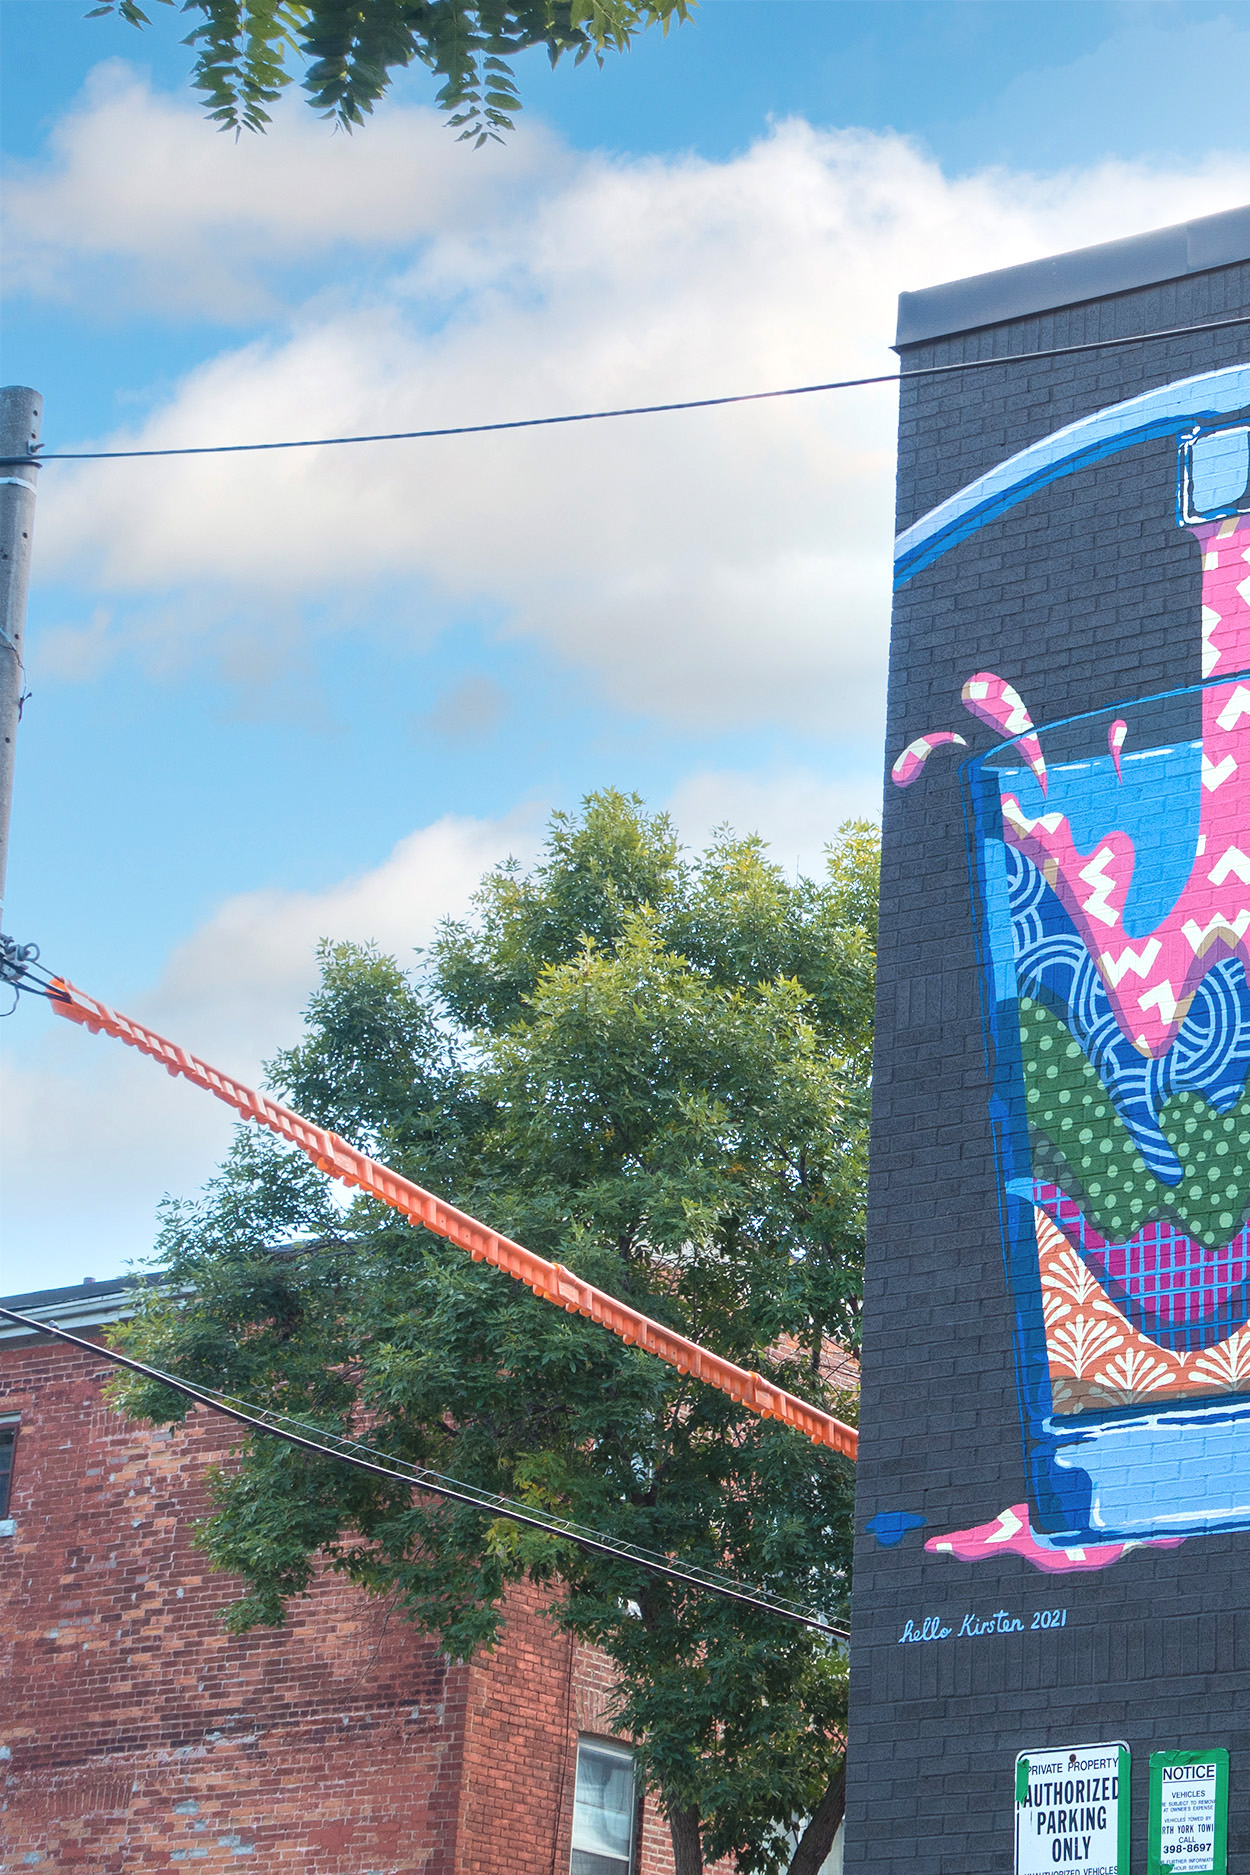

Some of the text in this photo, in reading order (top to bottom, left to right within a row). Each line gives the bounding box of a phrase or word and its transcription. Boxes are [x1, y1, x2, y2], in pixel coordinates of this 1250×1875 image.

[898, 1609, 1067, 1643] hello Kirsten 2021
[1028, 1758, 1119, 1776] PRIVATE PROPERTY
[1163, 1764, 1215, 1780] NOTICE
[1023, 1776, 1118, 1808] AUTHORIZED
[1171, 1790, 1206, 1798] VEHICLES
[1037, 1806, 1107, 1835] PARKING
[1178, 1824, 1194, 1834] YORK
[1052, 1836, 1091, 1862] ONLY
[1163, 1843, 1212, 1854] 398-8697
